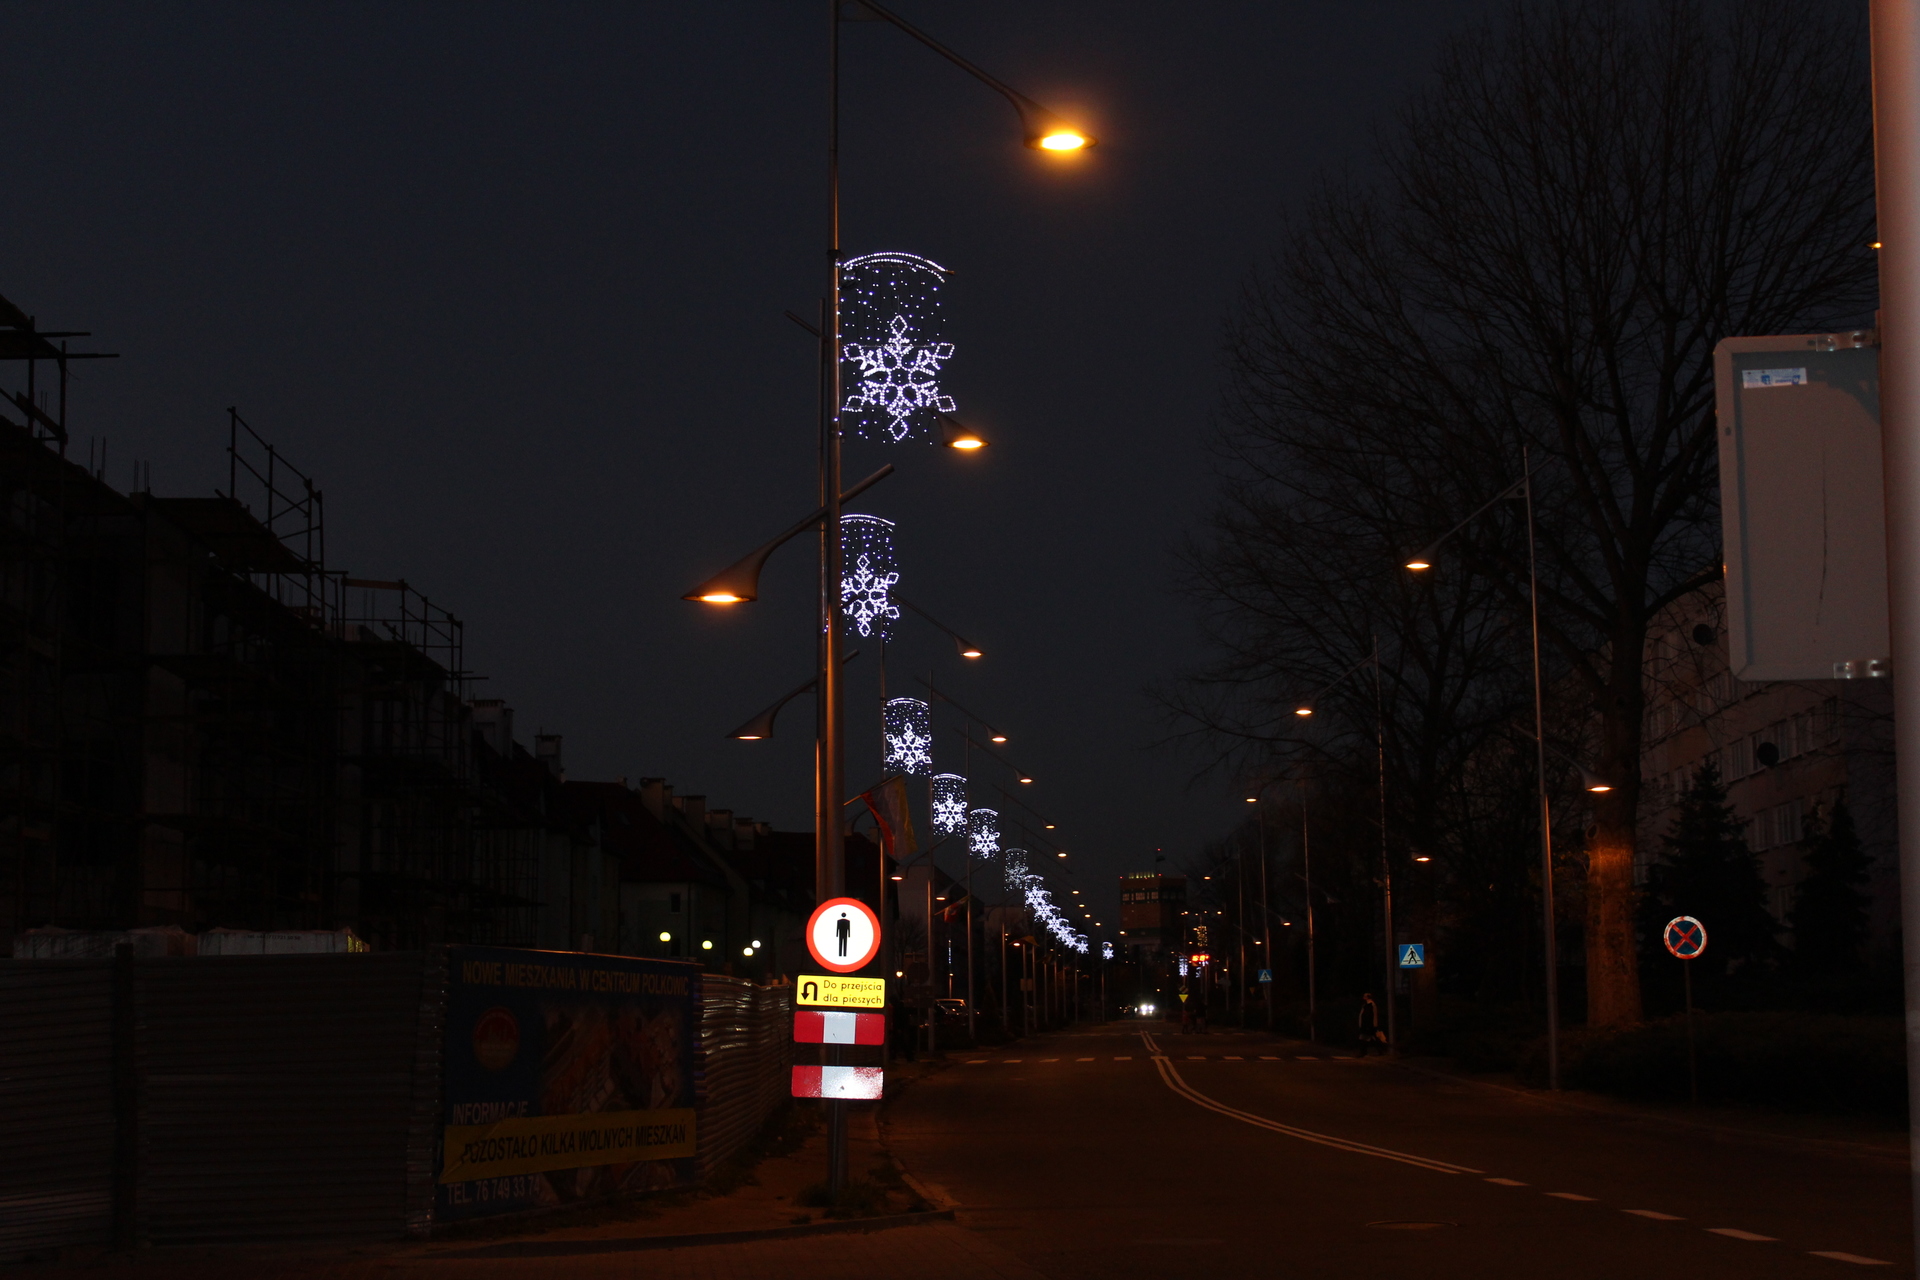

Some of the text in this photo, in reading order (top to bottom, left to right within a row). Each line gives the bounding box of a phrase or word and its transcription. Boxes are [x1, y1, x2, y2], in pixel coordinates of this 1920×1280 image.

[462, 961, 689, 997] NOWE MIESZKANIA W CENTRUM POLKOWIC
[823, 979, 882, 993] Do przejścia
[823, 994, 882, 1006] dla pieszych
[452, 1101, 528, 1125] INFORMACJE
[540, 1130, 576, 1155] KILKA
[578, 1126, 632, 1152] WOLNYCH
[635, 1119, 687, 1147] MIESZKAŃ
[446, 1181, 472, 1205] TEL.
[476, 1180, 489, 1202] 76
[491, 1177, 510, 1199] 749
[513, 1175, 525, 1197] 33
